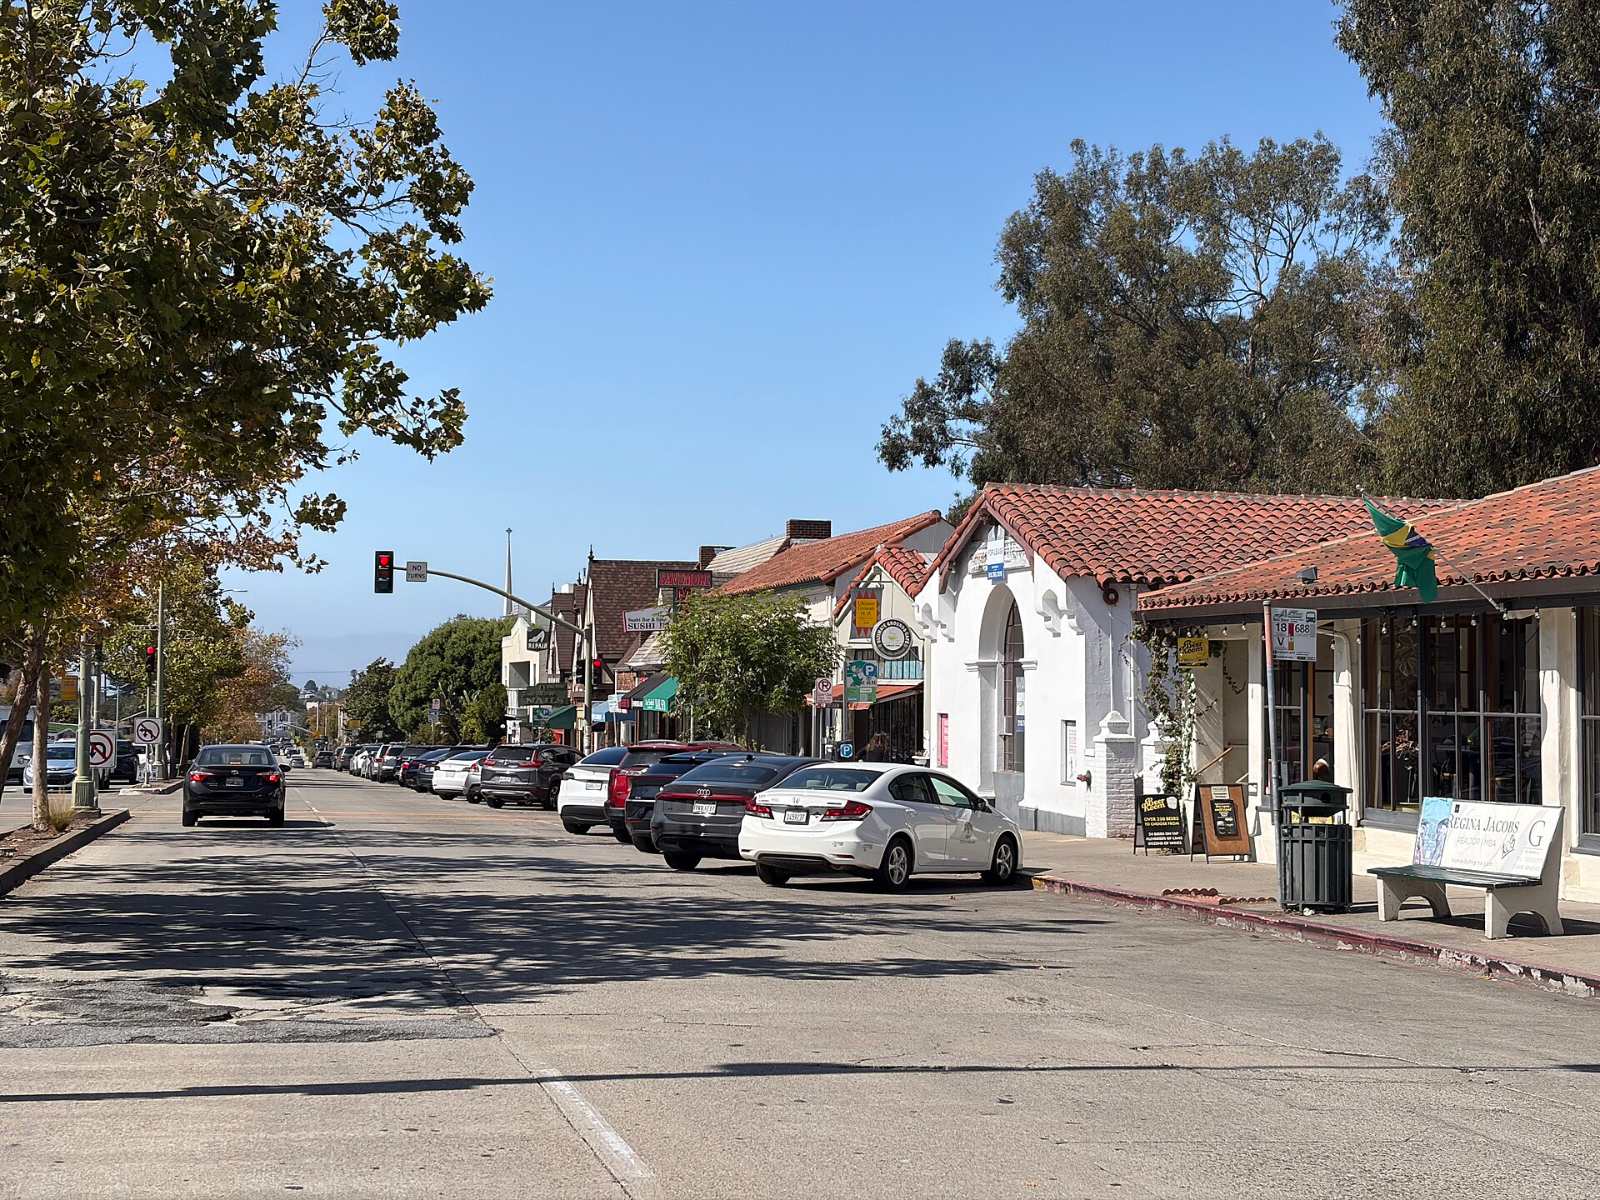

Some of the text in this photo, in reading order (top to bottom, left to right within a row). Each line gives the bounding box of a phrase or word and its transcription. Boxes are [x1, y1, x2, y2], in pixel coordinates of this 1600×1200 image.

[627, 622, 655, 630] SUSHI
[1276, 622, 1310, 633] 18 688
[528, 642, 548, 650] REPAIR
[1277, 636, 1285, 646] V
[1447, 815, 1520, 833] REGINA JACOBS
[1528, 820, 1546, 847] G
